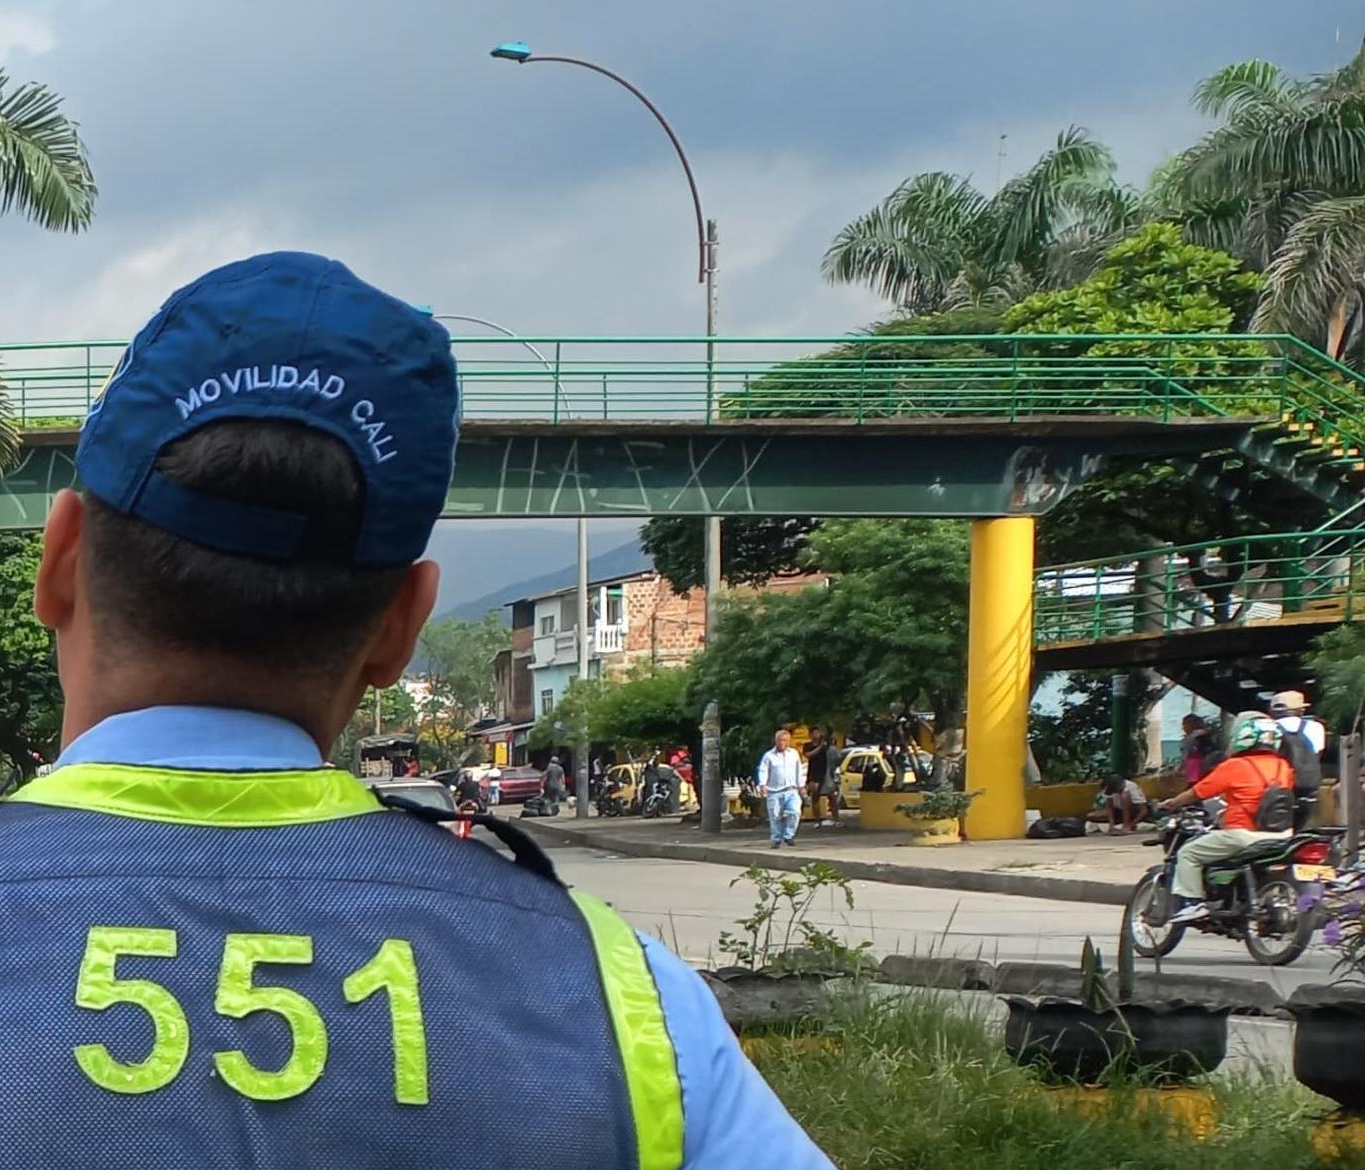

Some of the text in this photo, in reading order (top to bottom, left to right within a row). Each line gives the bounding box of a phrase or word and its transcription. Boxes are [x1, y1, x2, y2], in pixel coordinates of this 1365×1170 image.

[174, 364, 398, 464] MOVILIDAD CALI
[74, 926, 429, 1105] 551
